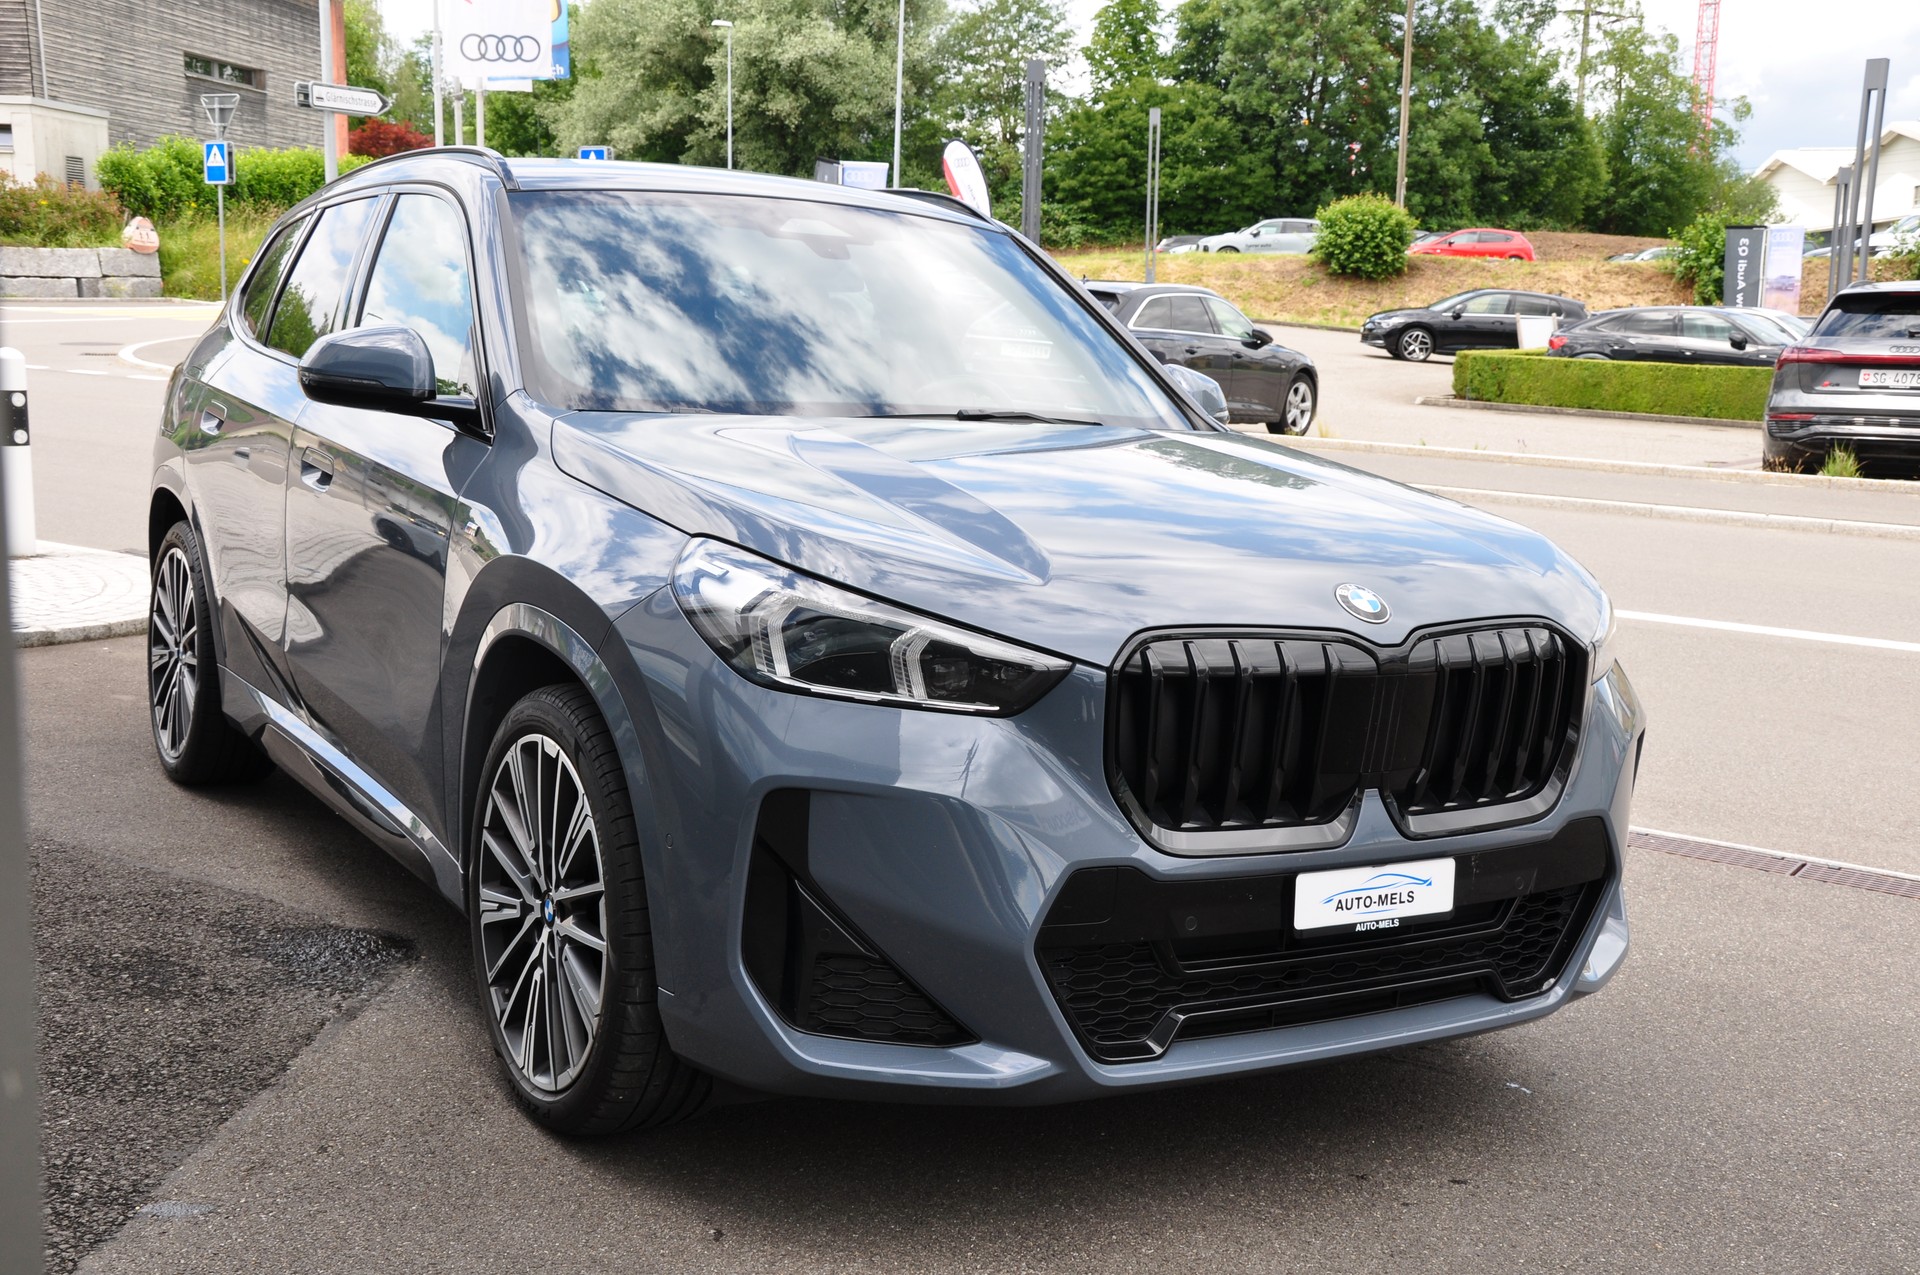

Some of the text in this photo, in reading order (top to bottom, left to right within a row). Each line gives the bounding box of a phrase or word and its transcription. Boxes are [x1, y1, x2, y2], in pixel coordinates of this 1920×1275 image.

[1873, 372, 1887, 384] SG
[1334, 890, 1415, 912] AUTO-MELS
[1355, 918, 1400, 932] AUTO-MELS
